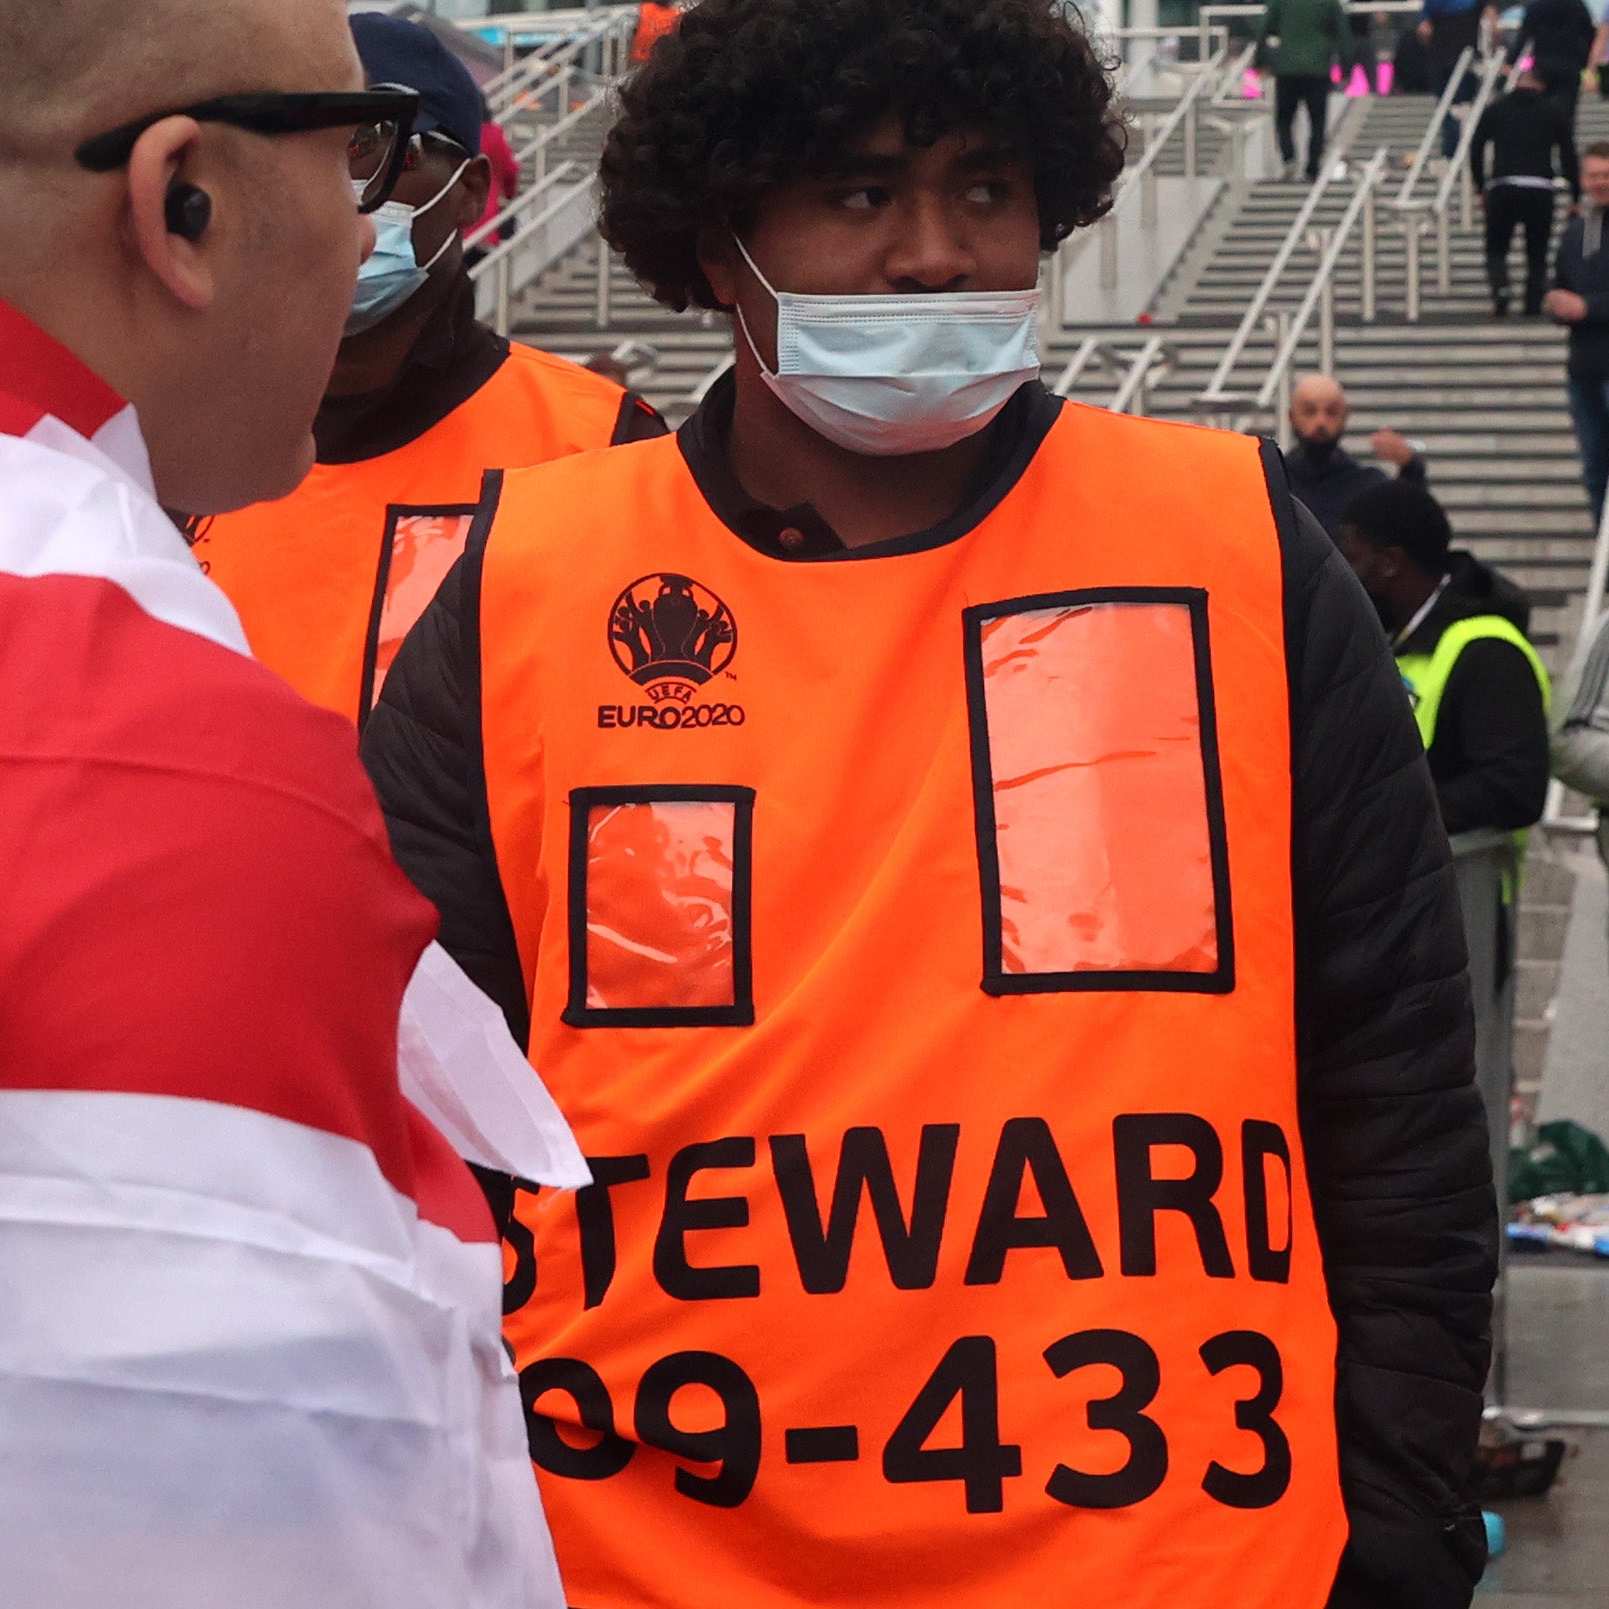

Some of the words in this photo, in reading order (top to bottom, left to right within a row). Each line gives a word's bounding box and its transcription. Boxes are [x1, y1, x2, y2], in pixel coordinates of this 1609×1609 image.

[645, 681, 697, 705] UEFA
[597, 703, 746, 730] EURO2020
[520, 1328, 1293, 1514] 09-433
